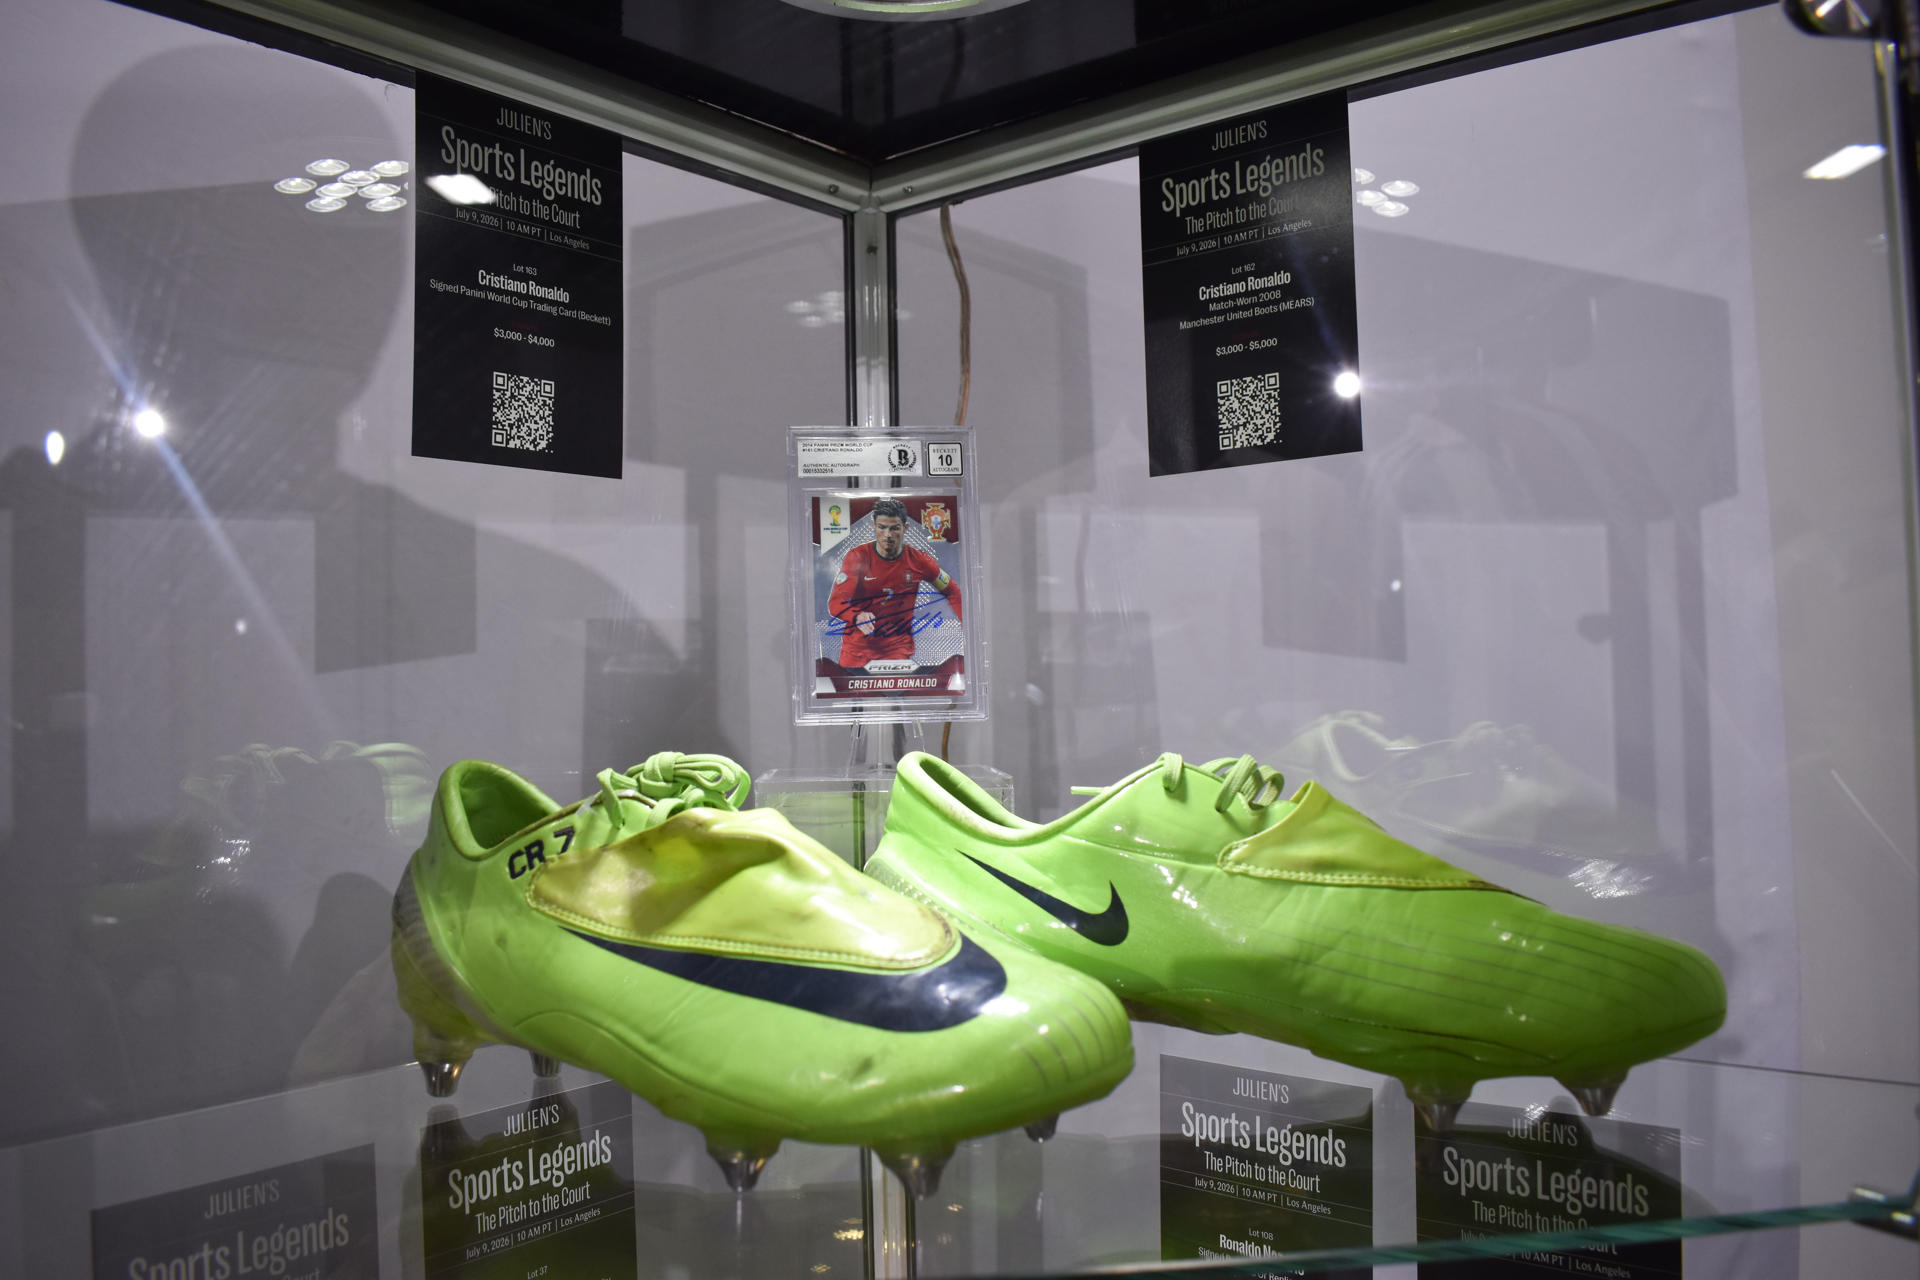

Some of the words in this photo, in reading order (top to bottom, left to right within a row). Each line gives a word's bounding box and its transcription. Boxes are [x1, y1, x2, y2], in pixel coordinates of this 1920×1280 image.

[497, 107, 551, 140] JULIEN'S
[1211, 120, 1268, 151] JULIEN'S
[441, 125, 515, 181] Sports
[520, 149, 602, 205] Legends
[1161, 168, 1231, 217] Sports
[1235, 143, 1325, 197] Legends
[456, 207, 469, 221] July
[480, 213, 499, 227] 2026
[507, 221, 515, 231] 10
[517, 224, 530, 234] AM
[531, 226, 542, 237] PT
[550, 231, 562, 243] Los
[563, 235, 590, 251] Angeles
[520, 196, 530, 215] to
[532, 200, 550, 220] the
[551, 204, 581, 229] Court
[1185, 216, 1205, 235] The
[1206, 207, 1234, 230] Pitch
[1235, 206, 1247, 222] to
[1248, 201, 1267, 221] the
[1176, 246, 1189, 257] July
[1199, 238, 1217, 251] 2026
[1223, 235, 1233, 245] 10
[1234, 231, 1247, 243] AM
[1248, 229, 1259, 240] PT
[1267, 226, 1281, 235] Los
[1282, 219, 1312, 232] Angeles
[478, 269, 527, 294] Cristiano
[529, 280, 570, 303] Ronaldo
[513, 264, 524, 273] Lot
[525, 267, 537, 276] 163
[1199, 280, 1246, 301] Cristiano
[1248, 270, 1291, 291] Ronaldo
[1231, 266, 1243, 275] Lot
[430, 278, 459, 294] Signed
[460, 286, 486, 299] Panini
[487, 291, 511, 305] World
[512, 296, 528, 309] Cup
[529, 300, 558, 316] Trading
[559, 306, 577, 319] Card
[577, 309, 611, 326] (Beckett)
[1179, 314, 1225, 330] Manchester
[1226, 307, 1253, 321] United
[1254, 304, 1278, 316] Boots
[1279, 296, 1315, 313] (MEARS)
[1209, 295, 1258, 312] Match-Worn
[1259, 289, 1281, 302] 2008
[493, 327, 522, 342] $3,000
[528, 334, 555, 348] $4,000
[1215, 343, 1244, 357] $3,000
[1249, 337, 1278, 351] $5,000
[938, 454, 953, 466] 10
[848, 679, 895, 689] CRISTIANO
[897, 678, 937, 688] RONALDO
[1232, 1077, 1289, 1104] JULIEN'S
[503, 1104, 559, 1137] JULIEN'S
[1181, 1101, 1251, 1149] Sports
[1255, 1115, 1347, 1168] Legends
[1507, 1118, 1577, 1147] JULIEN'S
[448, 1157, 524, 1215] Sports
[529, 1130, 612, 1188] Legends
[1204, 1151, 1223, 1173] The
[1225, 1152, 1252, 1179] Pitch
[1254, 1163, 1266, 1182] to
[1267, 1166, 1286, 1186] the
[1288, 1168, 1321, 1193] Court
[1443, 1146, 1530, 1197] Sports
[1536, 1159, 1649, 1216] Legends
[204, 1179, 280, 1219] JULIEN'S
[475, 1212, 496, 1234] The
[499, 1200, 526, 1227] Pitch
[529, 1200, 540, 1218] to
[542, 1192, 560, 1214] the
[562, 1181, 591, 1208] Court
[1195, 1177, 1208, 1190] July
[1218, 1181, 1235, 1194] 2026
[1242, 1187, 1251, 1198] 10
[1252, 1189, 1266, 1201] AM
[1267, 1192, 1278, 1203] PT
[1286, 1197, 1300, 1208] Los
[1301, 1200, 1331, 1215] Angeles
[466, 1246, 481, 1260] July
[490, 1235, 510, 1251] 2026
[517, 1231, 526, 1242] 10
[527, 1226, 541, 1239] AM
[542, 1221, 552, 1234] PT
[560, 1216, 573, 1228] Los
[574, 1207, 601, 1225] Angeles
[1472, 1200, 1496, 1224] The
[1499, 1205, 1533, 1232] Pitch
[1536, 1212, 1550, 1234] to
[237, 1208, 349, 1276] Legends
[1220, 1234, 1261, 1258] Ronaldo
[1249, 1228, 1260, 1237] Lot
[1261, 1231, 1274, 1241] 108
[527, 1270, 538, 1280] Lot
[1533, 1252, 1549, 1263] AM
[1552, 1254, 1564, 1266] PT
[1575, 1258, 1592, 1271] Los
[1594, 1263, 1631, 1279] Angeles
